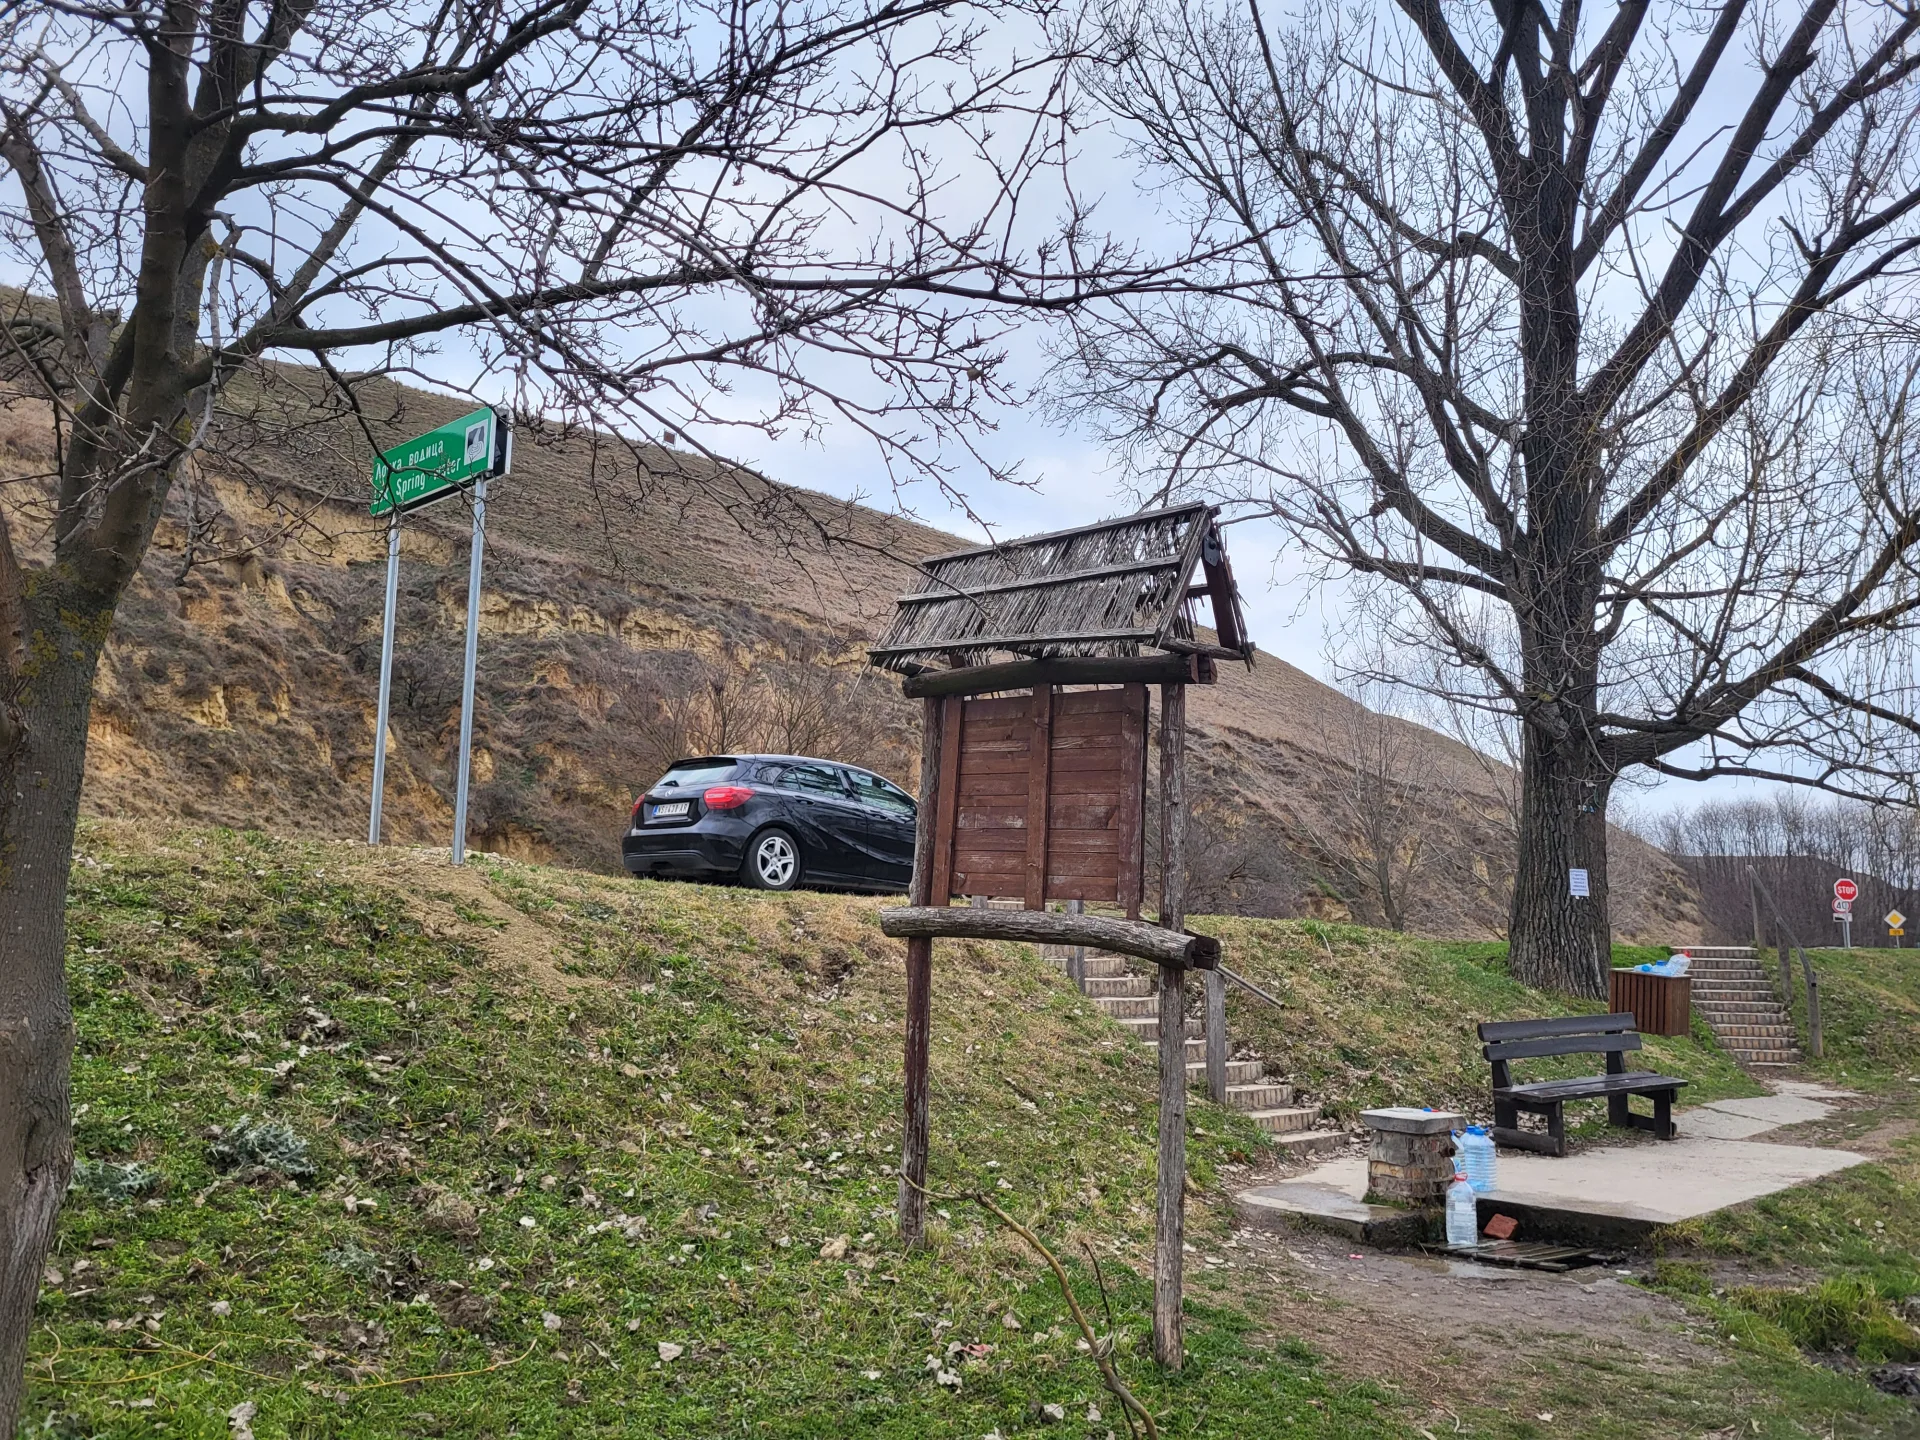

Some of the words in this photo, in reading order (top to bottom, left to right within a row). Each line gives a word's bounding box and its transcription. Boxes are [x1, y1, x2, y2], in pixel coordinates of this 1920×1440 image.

[408, 440, 444, 466] водица
[396, 472, 426, 498] Spring
[1837, 886, 1855, 895] STOP
